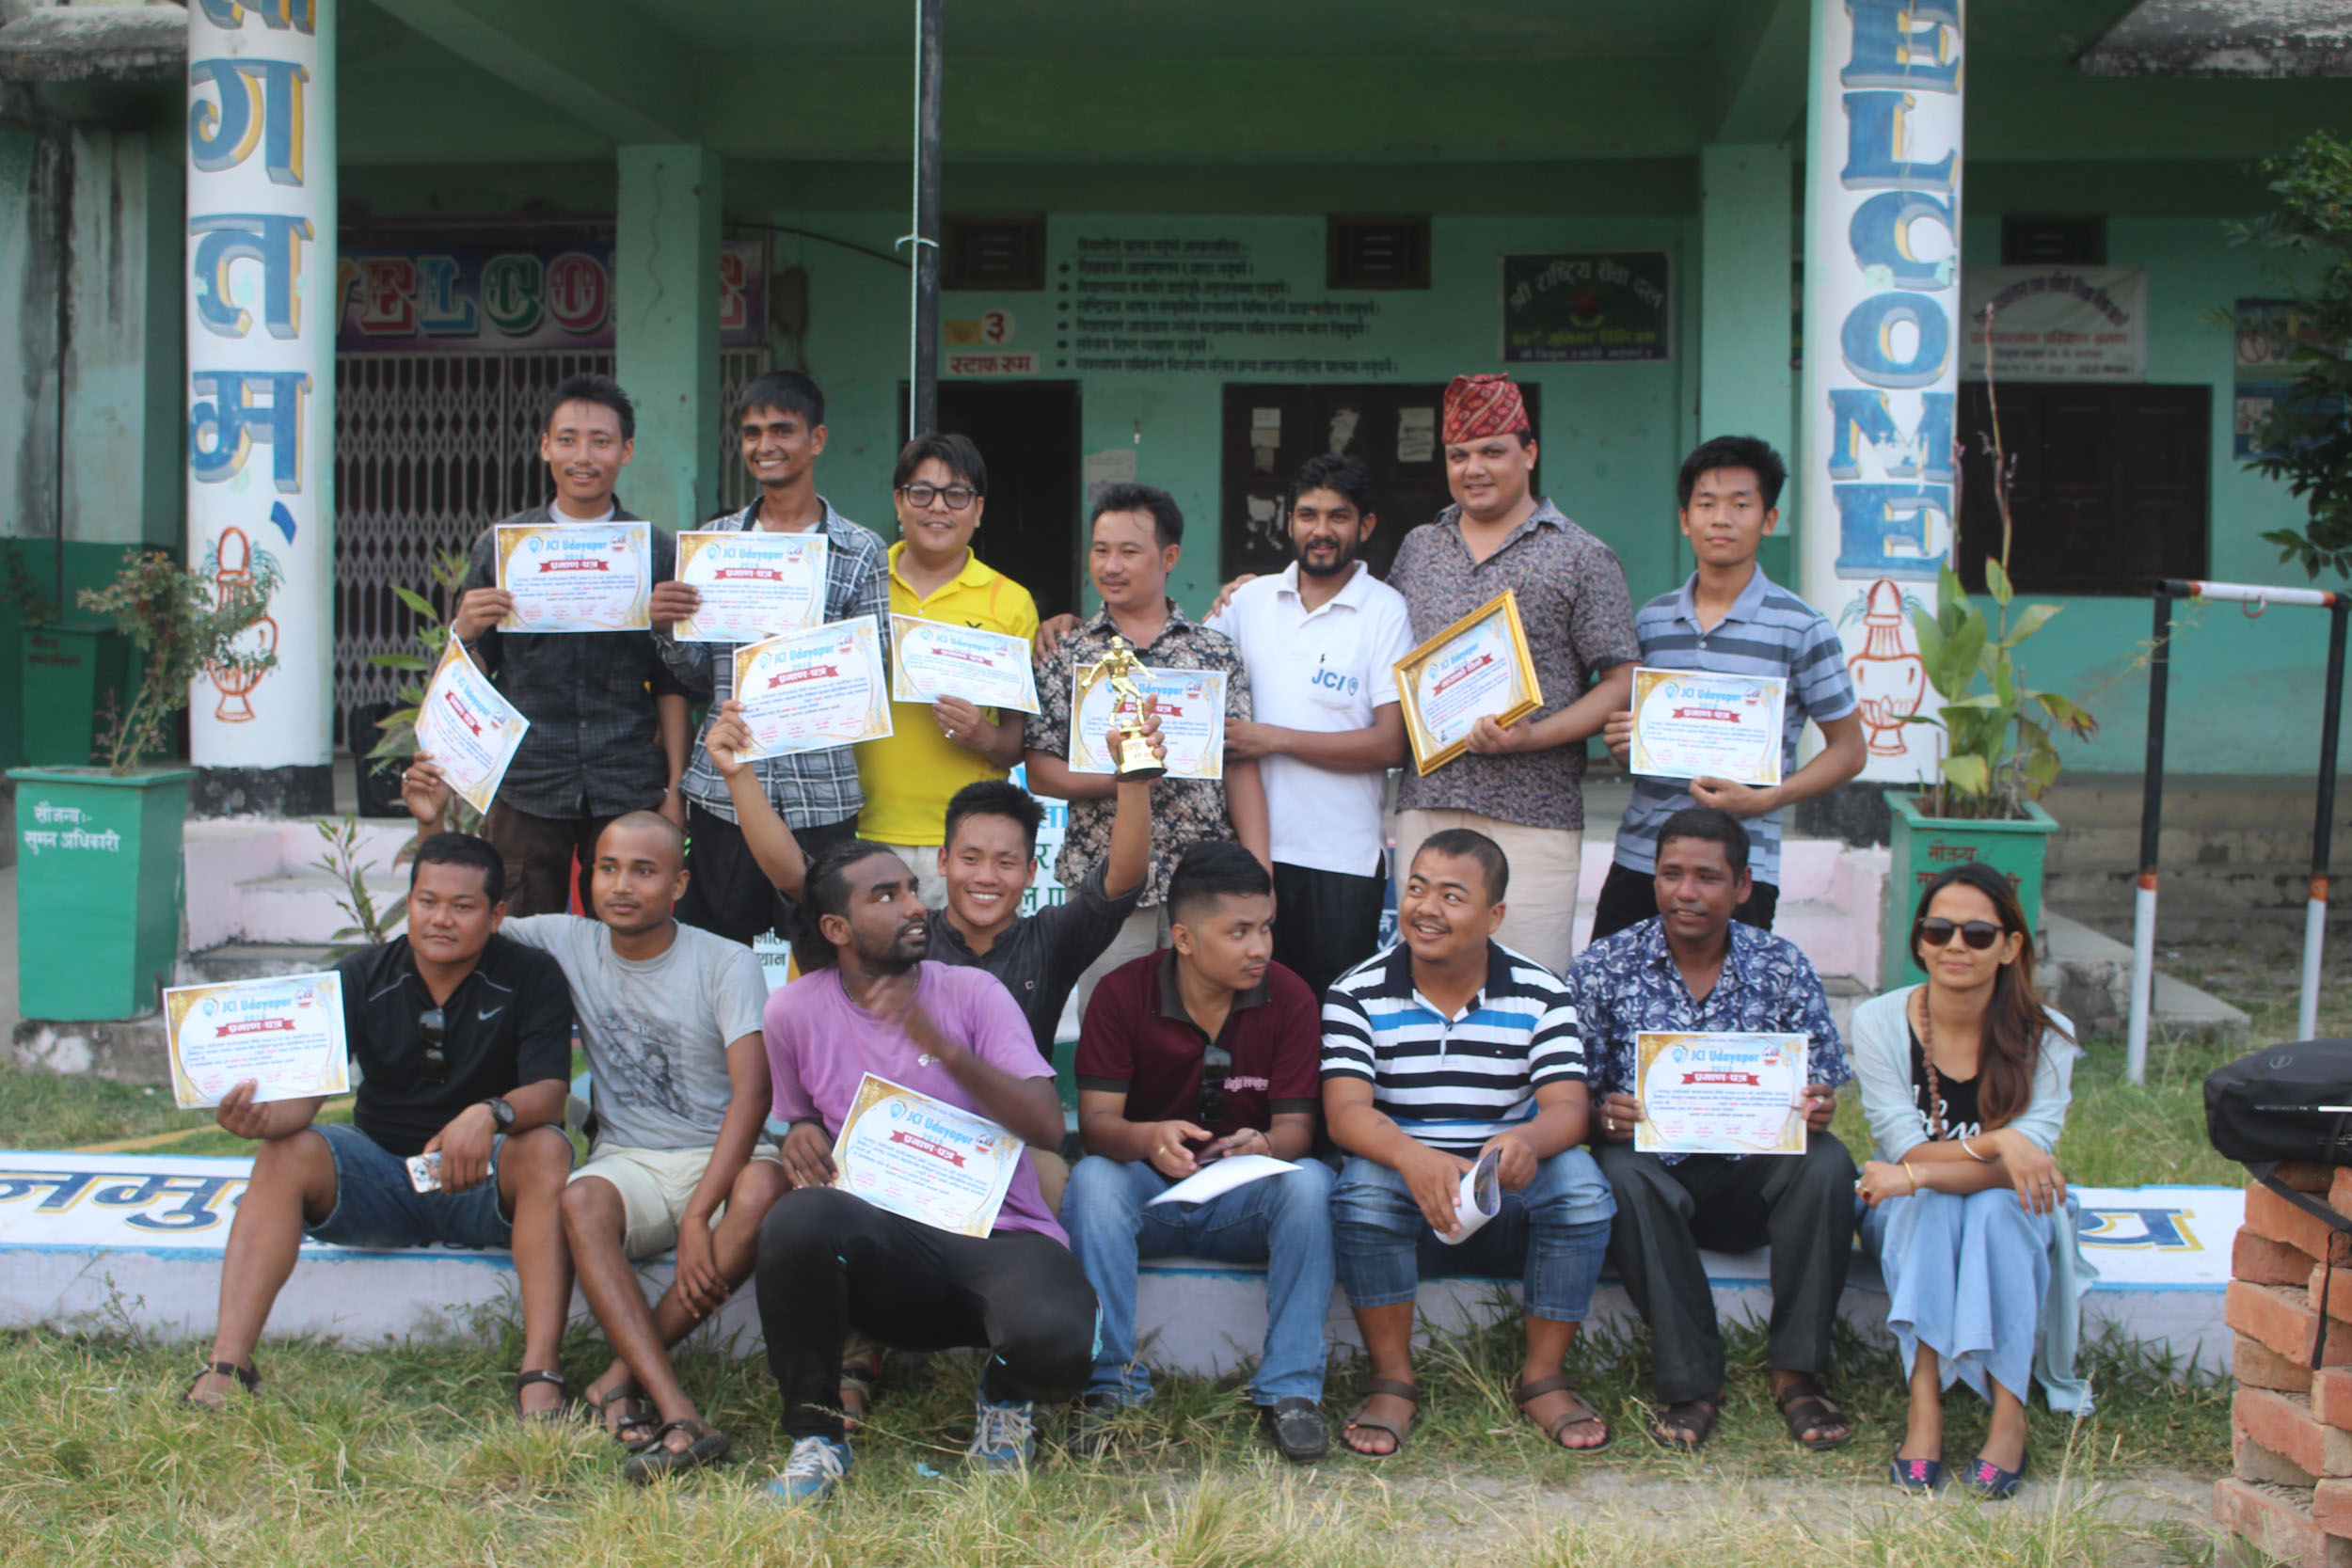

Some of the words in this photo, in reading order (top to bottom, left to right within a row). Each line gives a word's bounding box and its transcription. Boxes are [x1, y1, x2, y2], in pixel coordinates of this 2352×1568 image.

[337, 251, 749, 338] ELCOE
[985, 311, 1006, 344] ३
[545, 540, 558, 550] JCI
[723, 547, 738, 560] JCI
[772, 651, 786, 665] JCI
[1311, 668, 1346, 692] JCI
[1680, 687, 1693, 698] JCI
[24, 830, 58, 856] सुमन
[60, 827, 121, 853] अधिकारी
[220, 1000, 236, 1013] JCI
[1690, 1050, 1705, 1061] JCI
[1709, 1049, 1759, 1064] Udayapur
[906, 1110, 924, 1127] JCI
[925, 1117, 975, 1145] Udayapur
